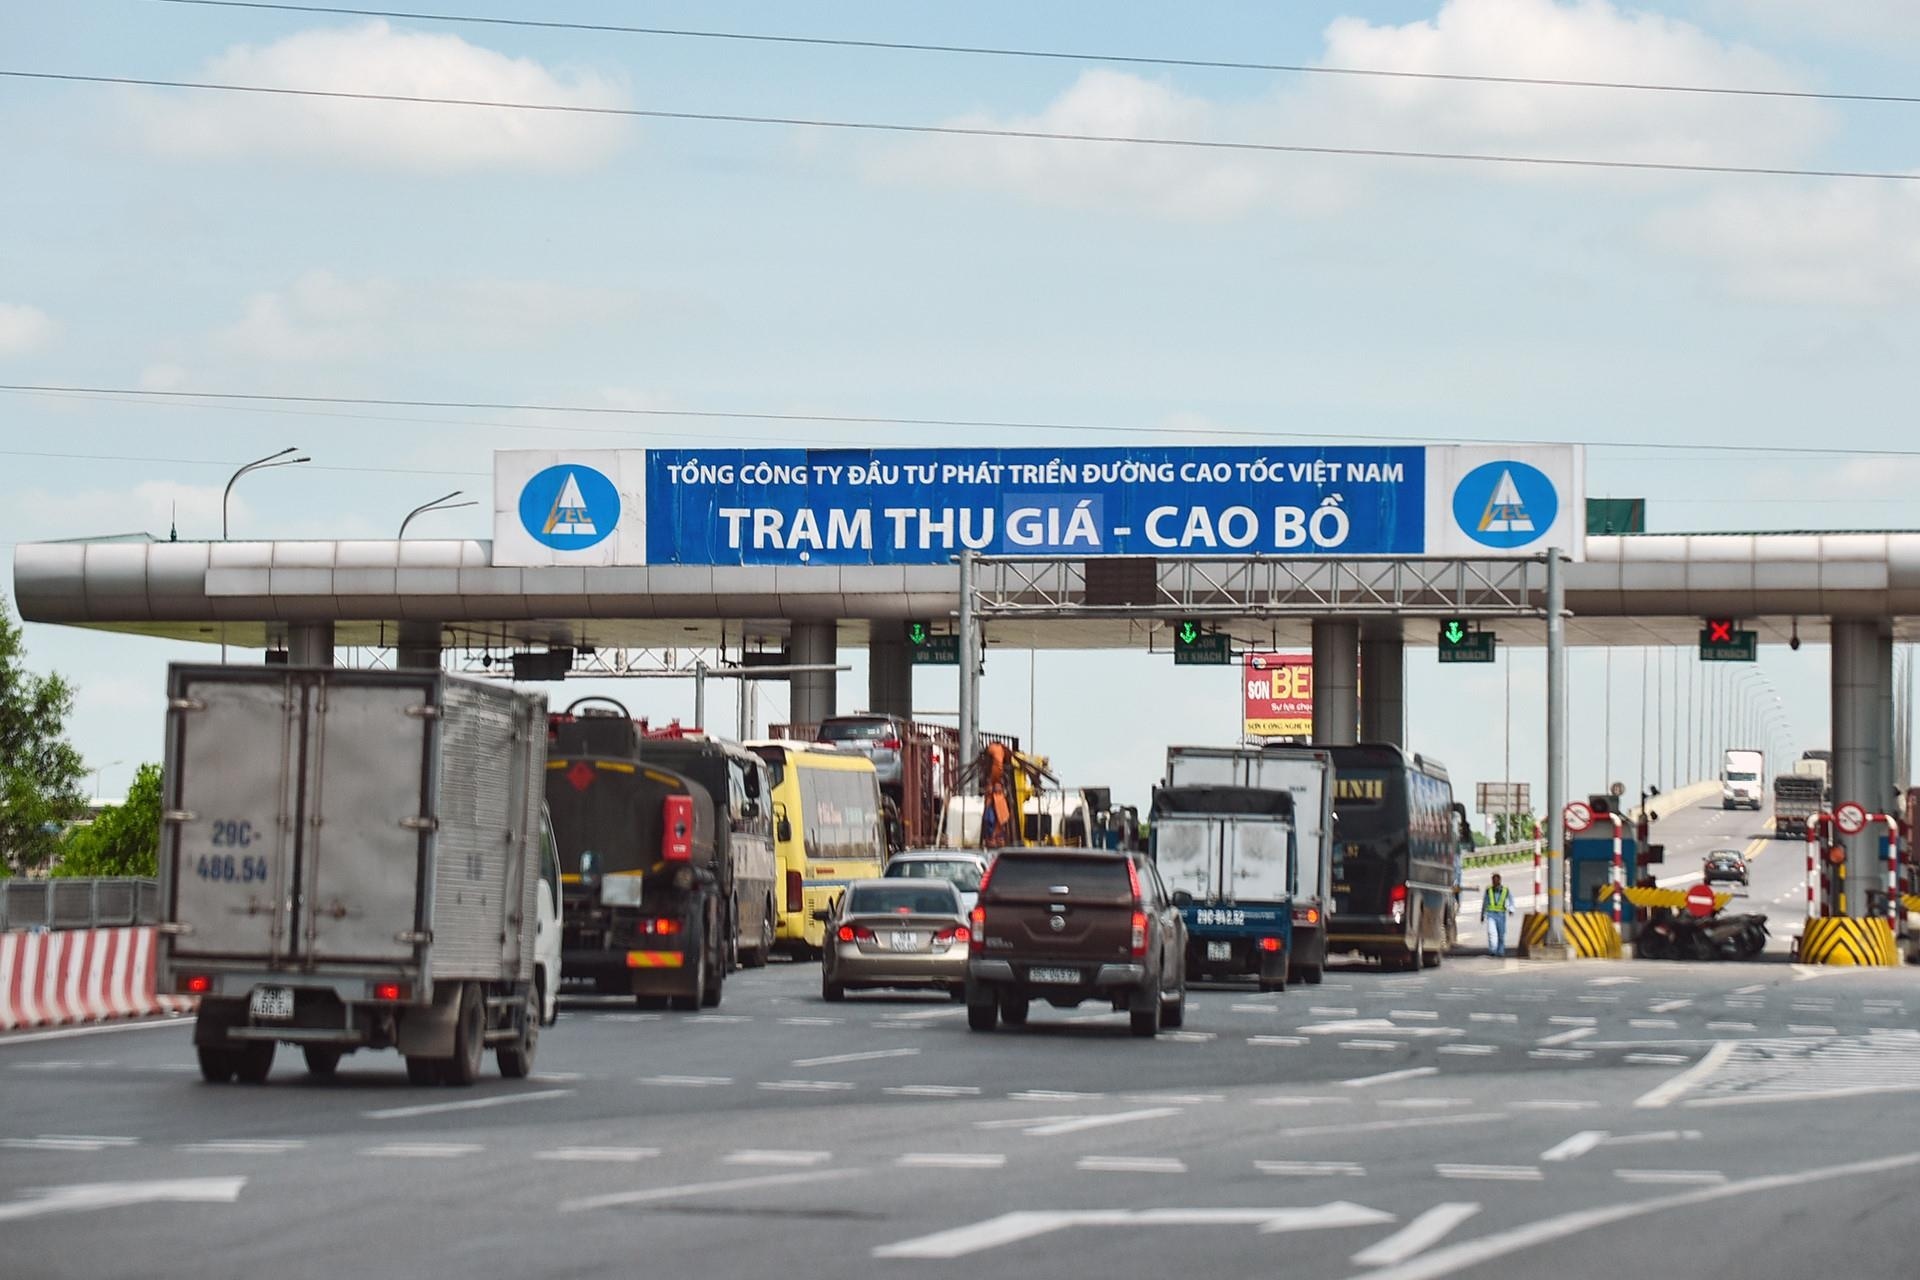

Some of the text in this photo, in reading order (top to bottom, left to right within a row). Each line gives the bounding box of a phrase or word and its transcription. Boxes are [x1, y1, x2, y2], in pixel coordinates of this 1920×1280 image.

[667, 457, 1404, 487] TỔNG CÔNG TY ĐẦU TƯ PHÁT TRIỂN ĐƯỜNG CAO TỐC VIỆT NAM
[719, 493, 1349, 562] TRẠM THU GIÁ - CAO BỒ
